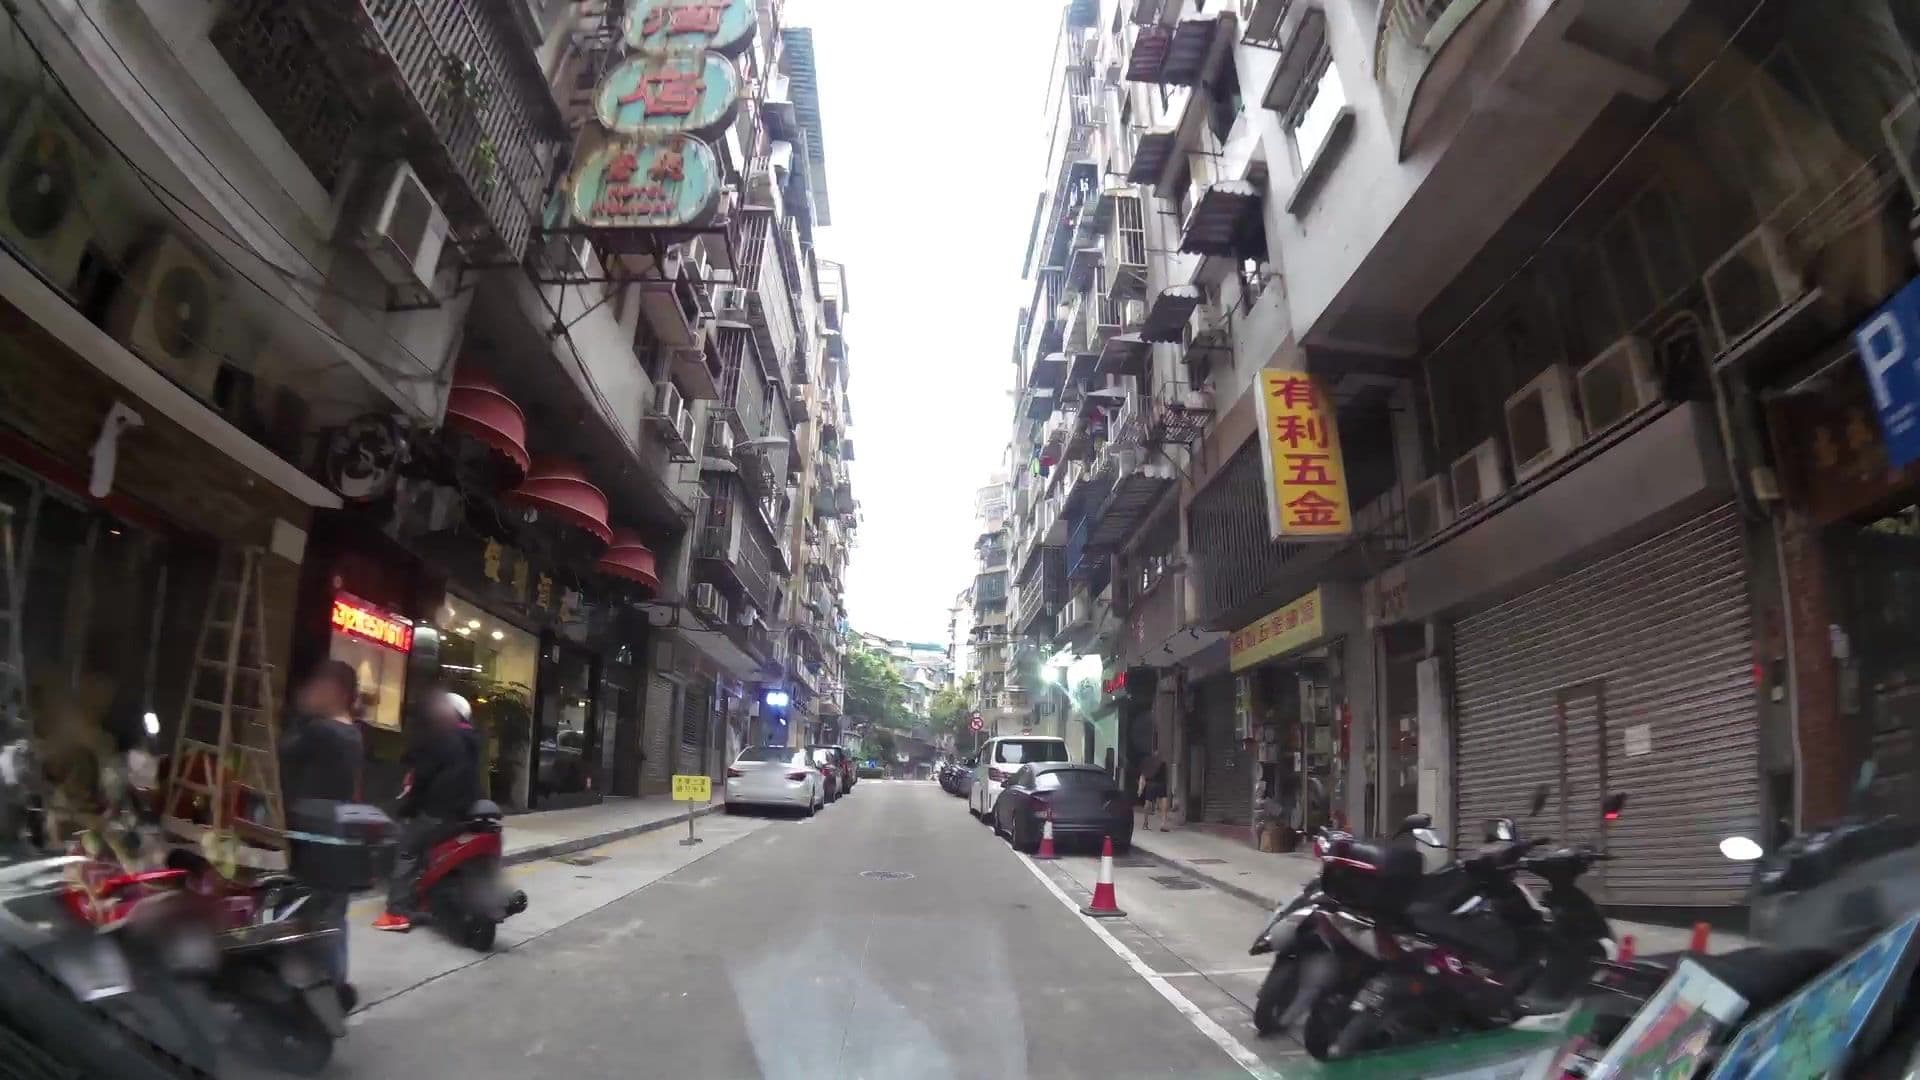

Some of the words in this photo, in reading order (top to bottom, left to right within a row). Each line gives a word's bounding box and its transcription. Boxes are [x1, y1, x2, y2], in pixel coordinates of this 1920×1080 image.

[1857, 311, 1905, 411] P
[1270, 376, 1341, 526] 有利五金
